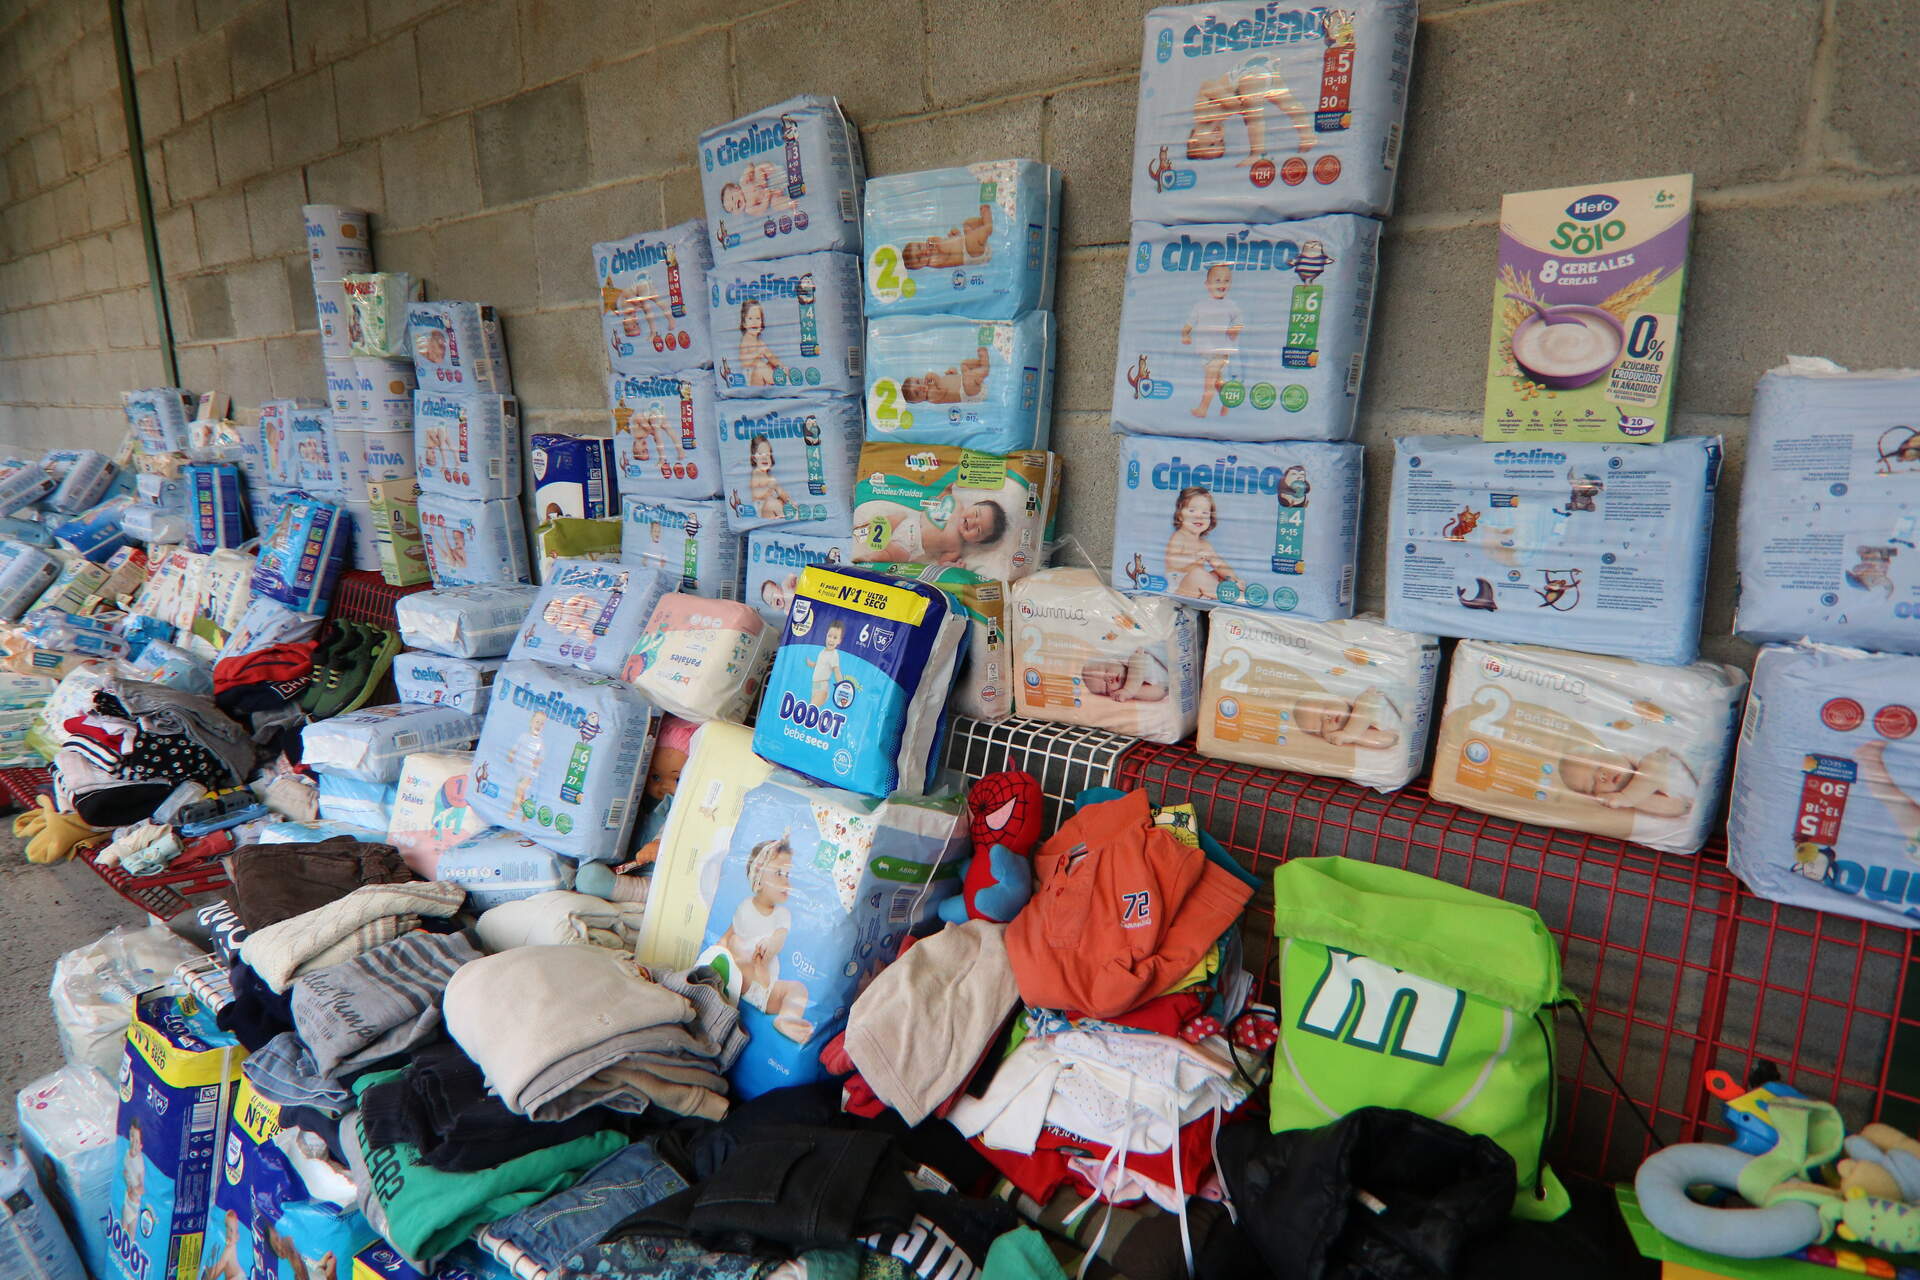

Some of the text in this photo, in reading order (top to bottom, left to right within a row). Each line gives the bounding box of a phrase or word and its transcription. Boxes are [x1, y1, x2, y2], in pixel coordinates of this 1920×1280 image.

[1183, 1, 1327, 58] chelino
[1337, 53, 1351, 73] 5
[1324, 75, 1348, 86] 13-18
[1320, 95, 1338, 108] 30
[717, 123, 785, 167] chelino
[792, 147, 799, 159] 3
[1655, 189, 1676, 204] 6+
[1573, 201, 1613, 215] Hero
[611, 239, 668, 275] chelino
[1160, 229, 1300, 273] chelino
[673, 270, 679, 282] 5
[875, 247, 900, 289] 2
[1539, 253, 1636, 284] 8 CEREALES
[725, 273, 801, 305] chelino
[1557, 275, 1599, 287] CEREAIS
[1306, 292, 1319, 311] 6
[806, 307, 814, 319] 4
[1291, 313, 1316, 324] 17-28
[1290, 333, 1307, 345] 27
[1626, 314, 1665, 362] 0%
[1610, 379, 1619, 389] NI
[1613, 369, 1661, 384] PRODUCIDOS
[624, 375, 682, 399] chelino
[875, 379, 898, 419] 2
[1224, 391, 1241, 401] 12H
[686, 405, 693, 416] 5
[734, 411, 806, 440] chelino
[1631, 418, 1643, 426] 20
[367, 452, 404, 465] ATIVA
[812, 447, 820, 459] 4
[1493, 448, 1567, 465] chelino
[906, 455, 942, 468] lupilu
[1152, 455, 1284, 496] chelino
[1288, 510, 1303, 527] 4
[872, 524, 883, 543] 2
[1280, 527, 1298, 537] 9-15
[690, 544, 697, 555] 6
[765, 541, 829, 569] chelino
[1278, 543, 1293, 555] 34
[838, 585, 862, 603] Nº1
[867, 591, 888, 602] ULTRA
[864, 598, 886, 610] SECO
[1021, 604, 1032, 614] ifa
[859, 624, 870, 643] 6
[1229, 624, 1242, 636] ifa
[1022, 625, 1044, 665] 2
[1220, 647, 1251, 694] 2
[1484, 660, 1501, 673] ifa
[512, 680, 588, 730] chelino
[1469, 684, 1512, 738] 2
[778, 690, 848, 739] DODOT
[1514, 708, 1571, 731] Pañales
[805, 735, 829, 751] seco
[580, 750, 589, 763] 6
[567, 775, 578, 785] 27
[1820, 781, 1846, 798] 30
[1805, 802, 1840, 817] 13-18
[1800, 815, 1819, 837] 5
[1122, 890, 1150, 921] 72
[244, 1103, 267, 1138] Nº1
